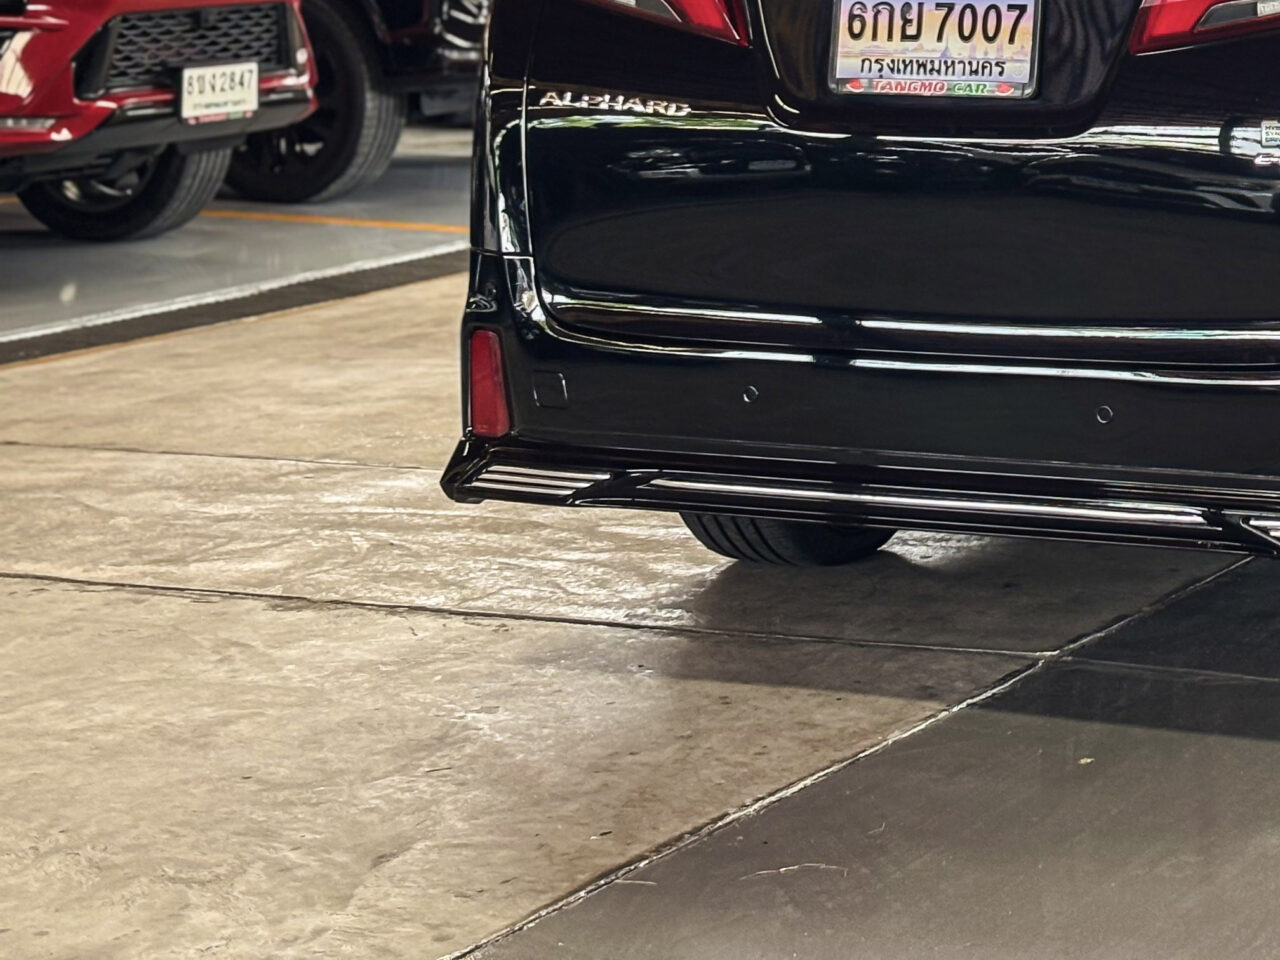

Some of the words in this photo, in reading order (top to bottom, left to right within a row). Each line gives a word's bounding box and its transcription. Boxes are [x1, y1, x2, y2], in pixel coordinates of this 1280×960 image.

[847, 1, 925, 42] 6กย
[934, 2, 1028, 45] 7007
[860, 57, 1006, 78] กรุงเทพมหานคร
[873, 80, 947, 95] TANGMO
[950, 82, 988, 95] CAR
[539, 91, 691, 116] ALPHARD
